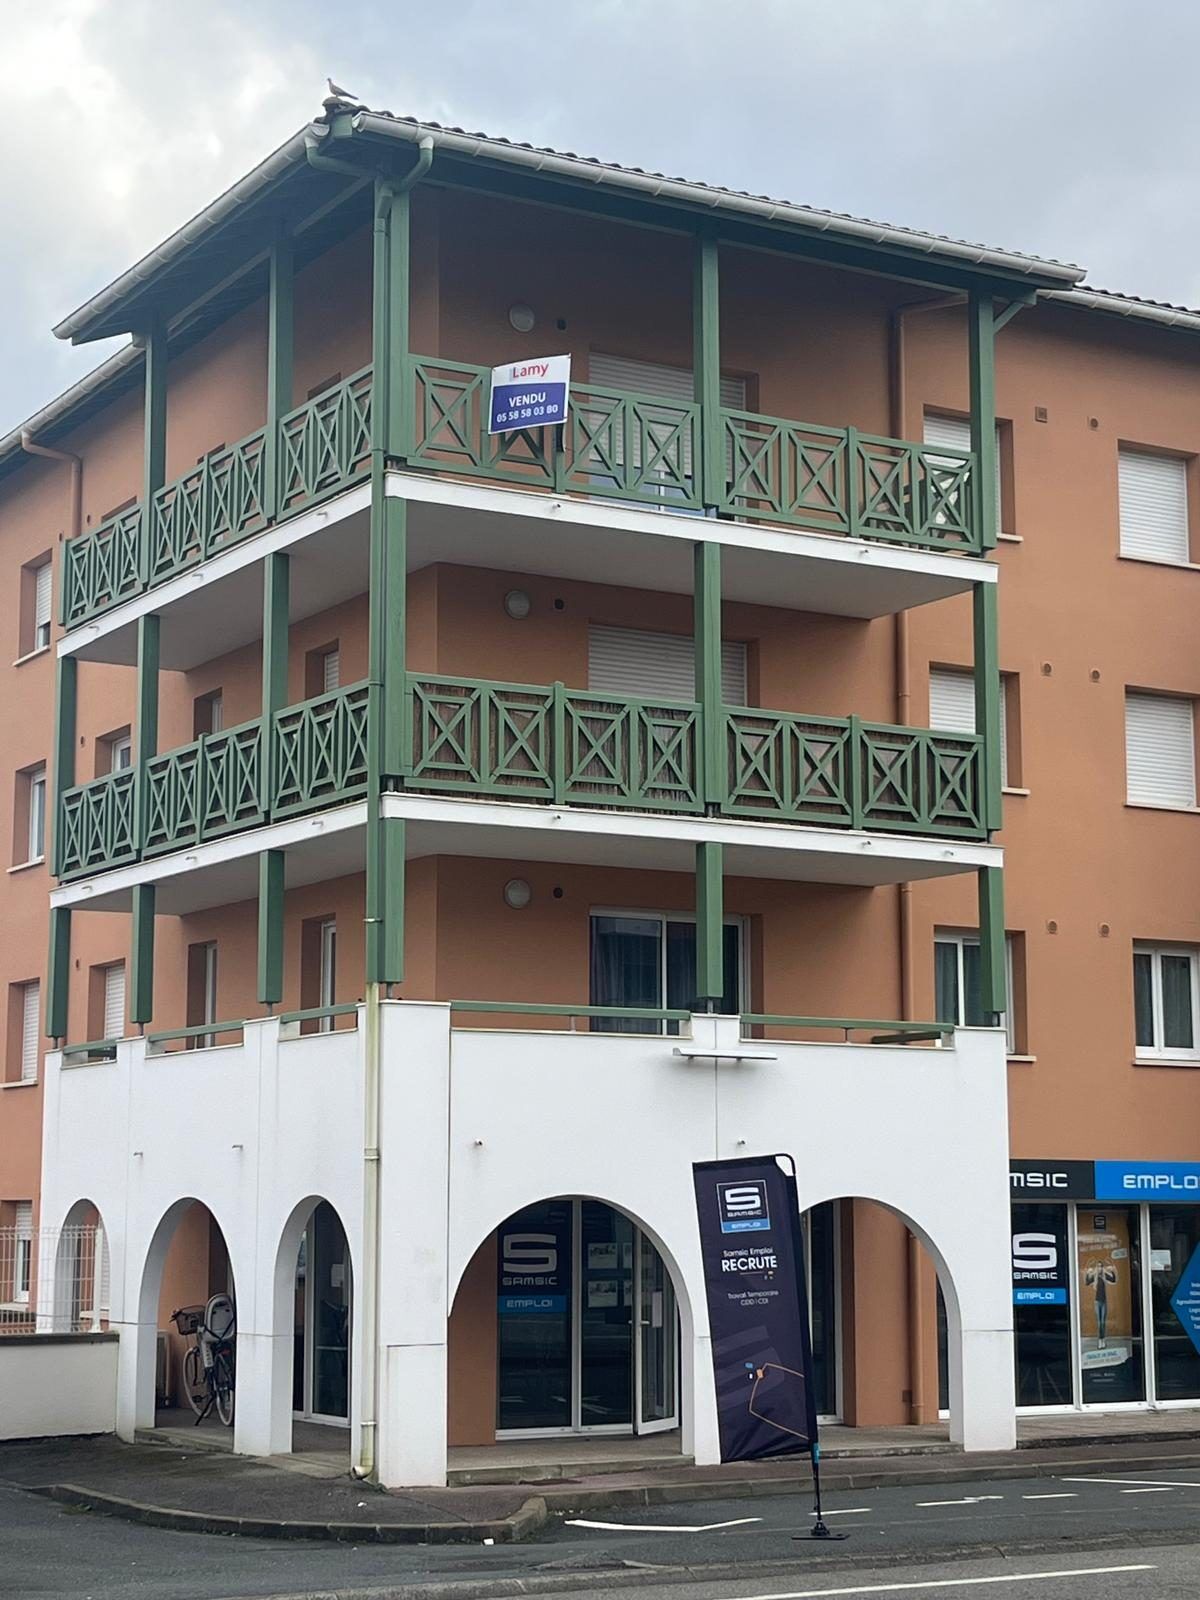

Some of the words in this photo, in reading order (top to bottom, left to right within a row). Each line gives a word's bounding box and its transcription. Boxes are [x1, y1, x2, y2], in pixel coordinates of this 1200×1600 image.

[513, 364, 549, 378] Lamy
[509, 392, 546, 407] VENDU
[496, 413, 507, 423] 05
[508, 410, 519, 421] 58
[520, 408, 531, 418] 58
[533, 406, 544, 416] 03
[723, 1249, 748, 1257] Samsic
[750, 1247, 773, 1255] Emploi
[721, 1256, 777, 1272] RECRUTE
[1013, 1271, 1058, 1280] SAMSIC
[502, 1276, 558, 1286] SAMSIC
[1017, 1292, 1055, 1300] EMPLOI
[506, 1299, 553, 1308] EMPLOI
